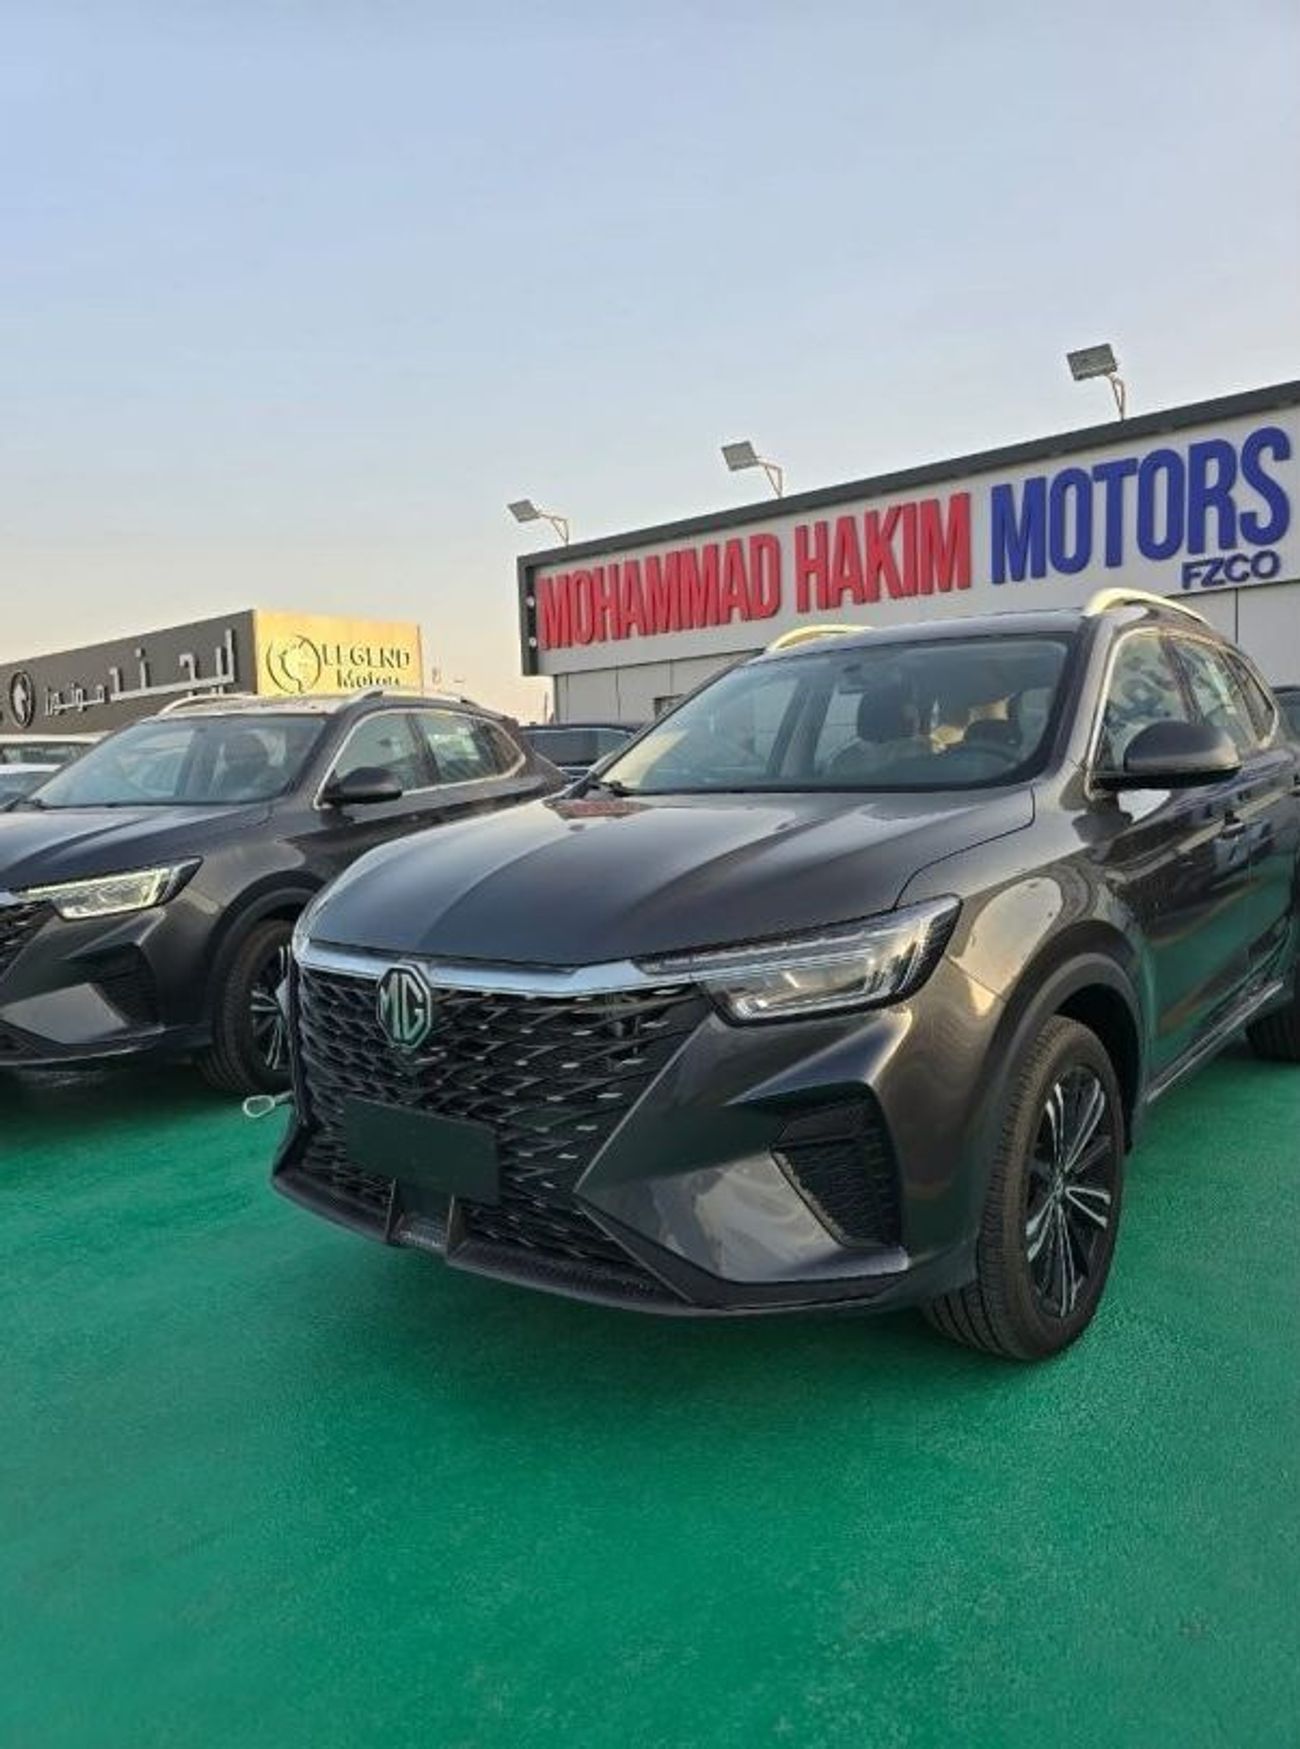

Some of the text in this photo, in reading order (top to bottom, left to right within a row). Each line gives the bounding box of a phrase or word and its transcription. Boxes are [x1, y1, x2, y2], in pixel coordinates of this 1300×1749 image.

[535, 426, 1291, 651] MOHAMMAD HAKIM MOTORS
[1181, 549, 1281, 590] FZCO
[321, 643, 411, 670] LEGEND
[380, 970, 425, 1041] MG
